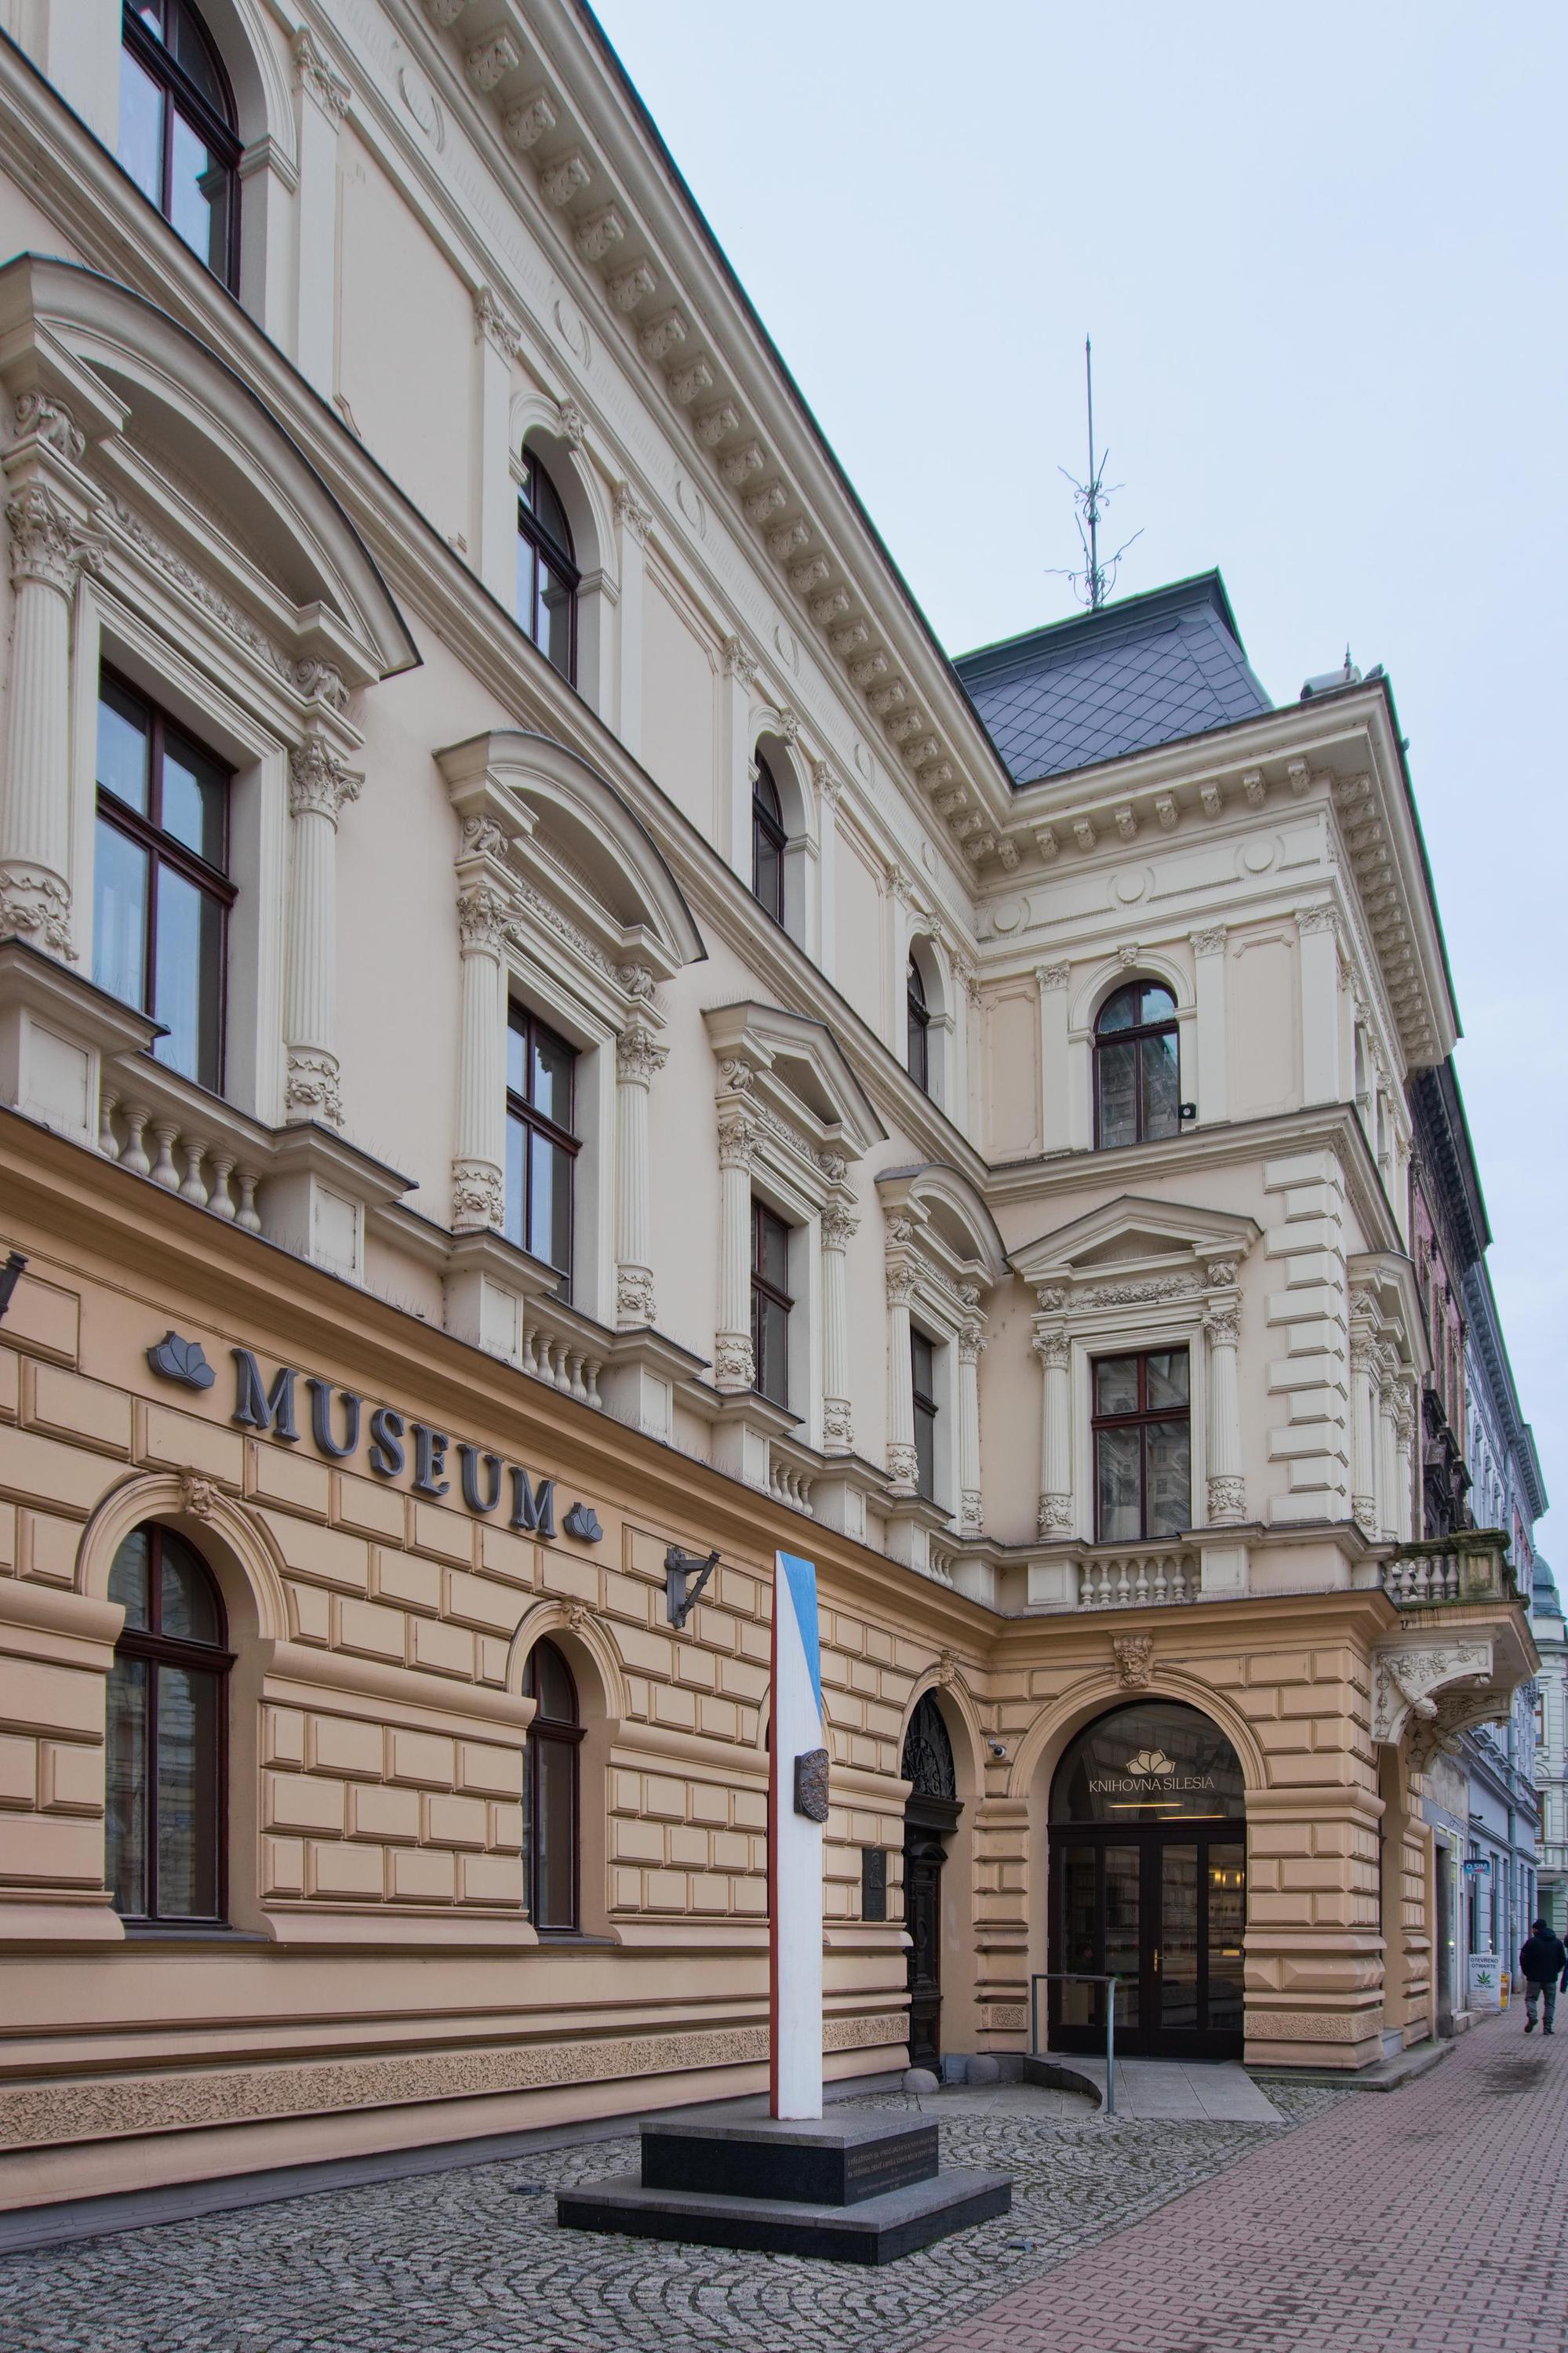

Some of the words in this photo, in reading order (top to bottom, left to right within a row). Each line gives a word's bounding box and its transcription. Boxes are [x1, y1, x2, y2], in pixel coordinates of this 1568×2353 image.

[230, 1347, 558, 1540] MUSEUM
[1089, 1777, 1162, 1793] KNIHOVNA
[1163, 1777, 1215, 1791] SILESIA
